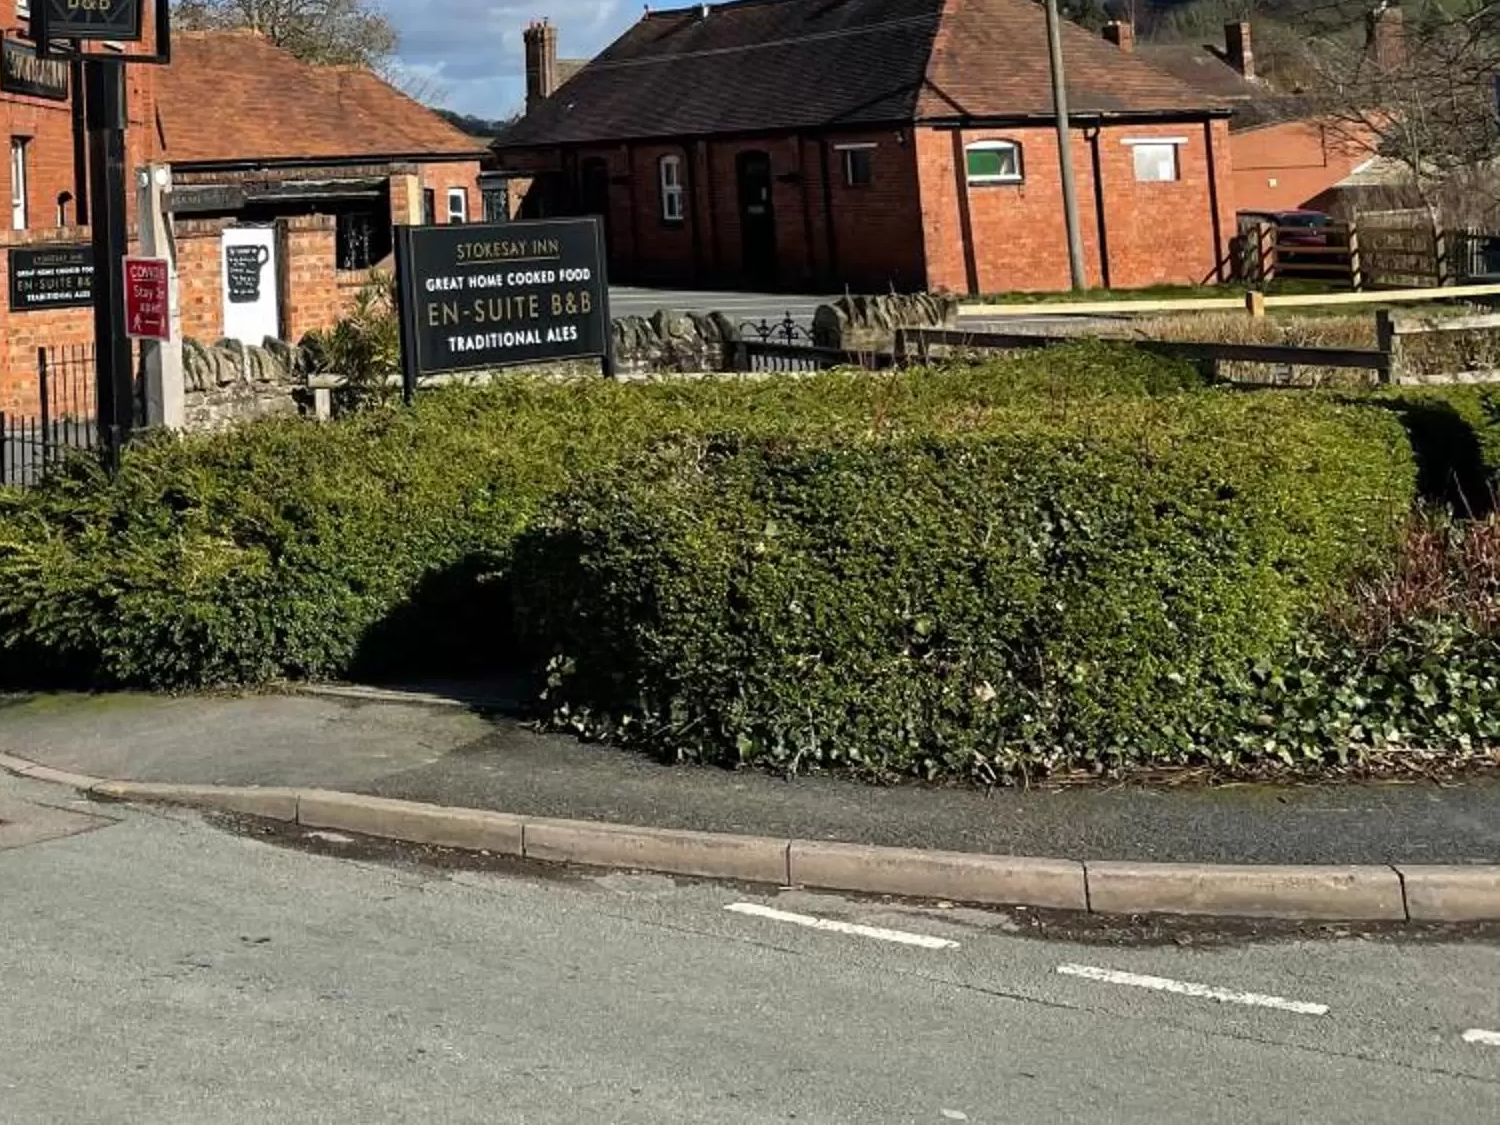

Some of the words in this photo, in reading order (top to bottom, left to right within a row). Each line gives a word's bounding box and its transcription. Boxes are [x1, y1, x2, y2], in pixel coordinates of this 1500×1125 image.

[456, 240, 528, 260] STOKESAY
[533, 238, 560, 255] INN
[425, 276, 464, 292] GREAT
[469, 274, 503, 289] HOME
[507, 270, 555, 286] COOKED
[559, 268, 592, 282] FOOD
[427, 295, 540, 327] EN-SUITE
[551, 291, 592, 316] B&B
[448, 329, 543, 352] TRADITIONAL
[547, 326, 578, 343] ALES
